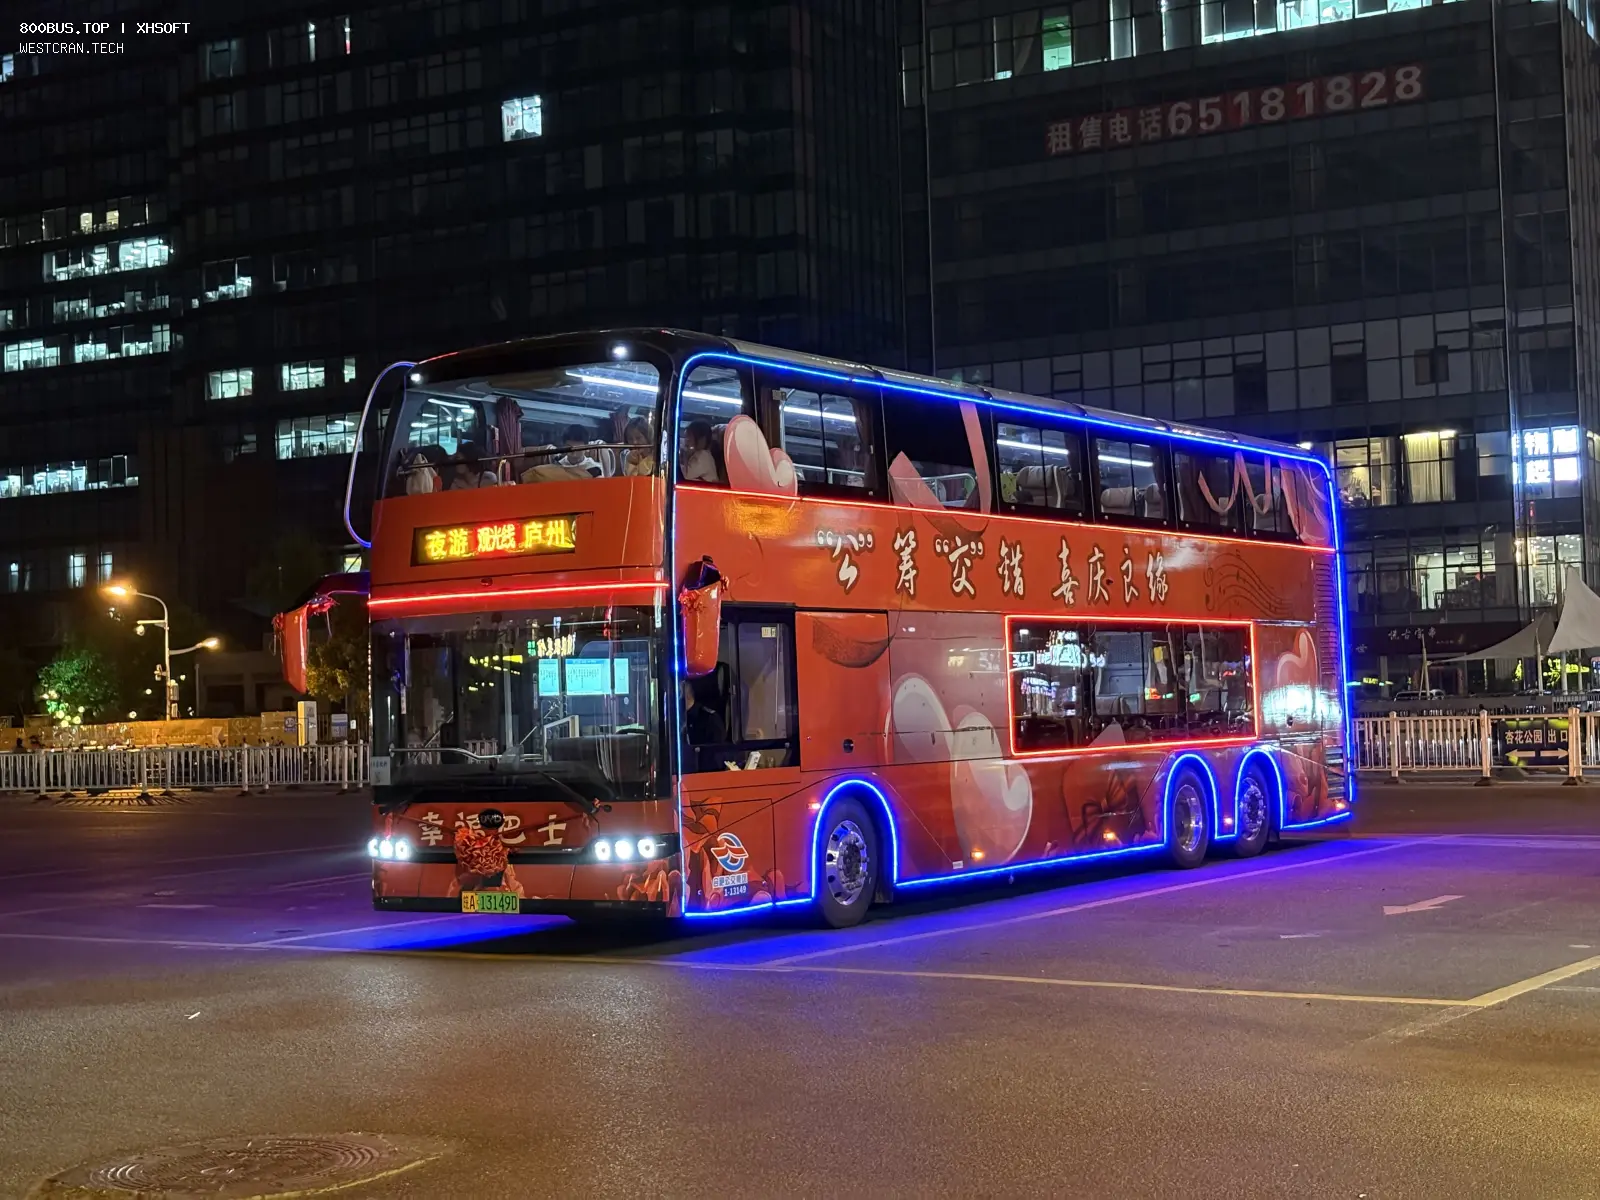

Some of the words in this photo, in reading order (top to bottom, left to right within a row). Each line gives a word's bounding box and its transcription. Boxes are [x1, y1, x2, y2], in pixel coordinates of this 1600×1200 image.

[425, 527, 469, 557] 夜游
[477, 523, 516, 553] 观光线
[524, 519, 566, 549] 庐州
[1052, 539, 1169, 605] 喜庆良缘
[1505, 729, 1543, 745] 杏花公园
[1547, 728, 1568, 743] 出口
[724, 885, 747, 897] 1-13149
